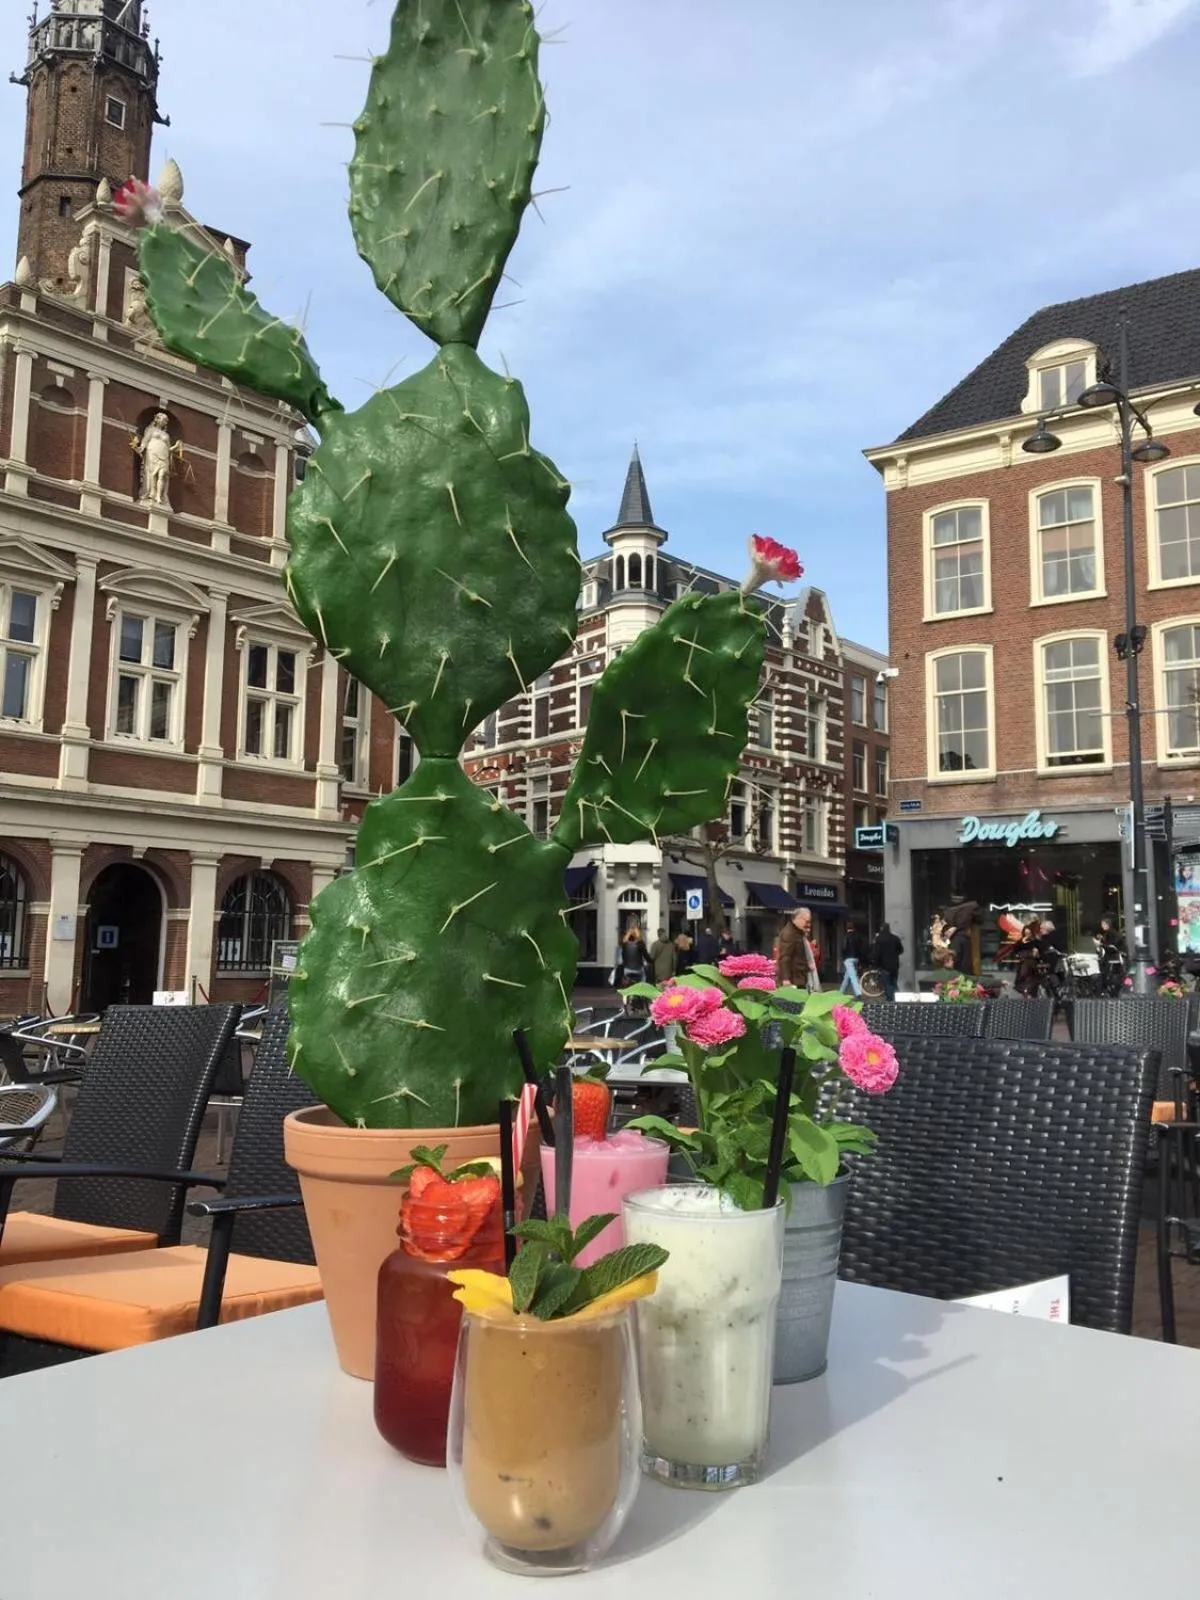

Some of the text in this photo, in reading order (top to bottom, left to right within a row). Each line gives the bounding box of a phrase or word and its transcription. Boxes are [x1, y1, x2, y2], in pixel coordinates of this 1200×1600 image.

[959, 809, 1058, 848] Douglas
[804, 885, 835, 898] Leonidas
[989, 902, 1053, 912] MAC
